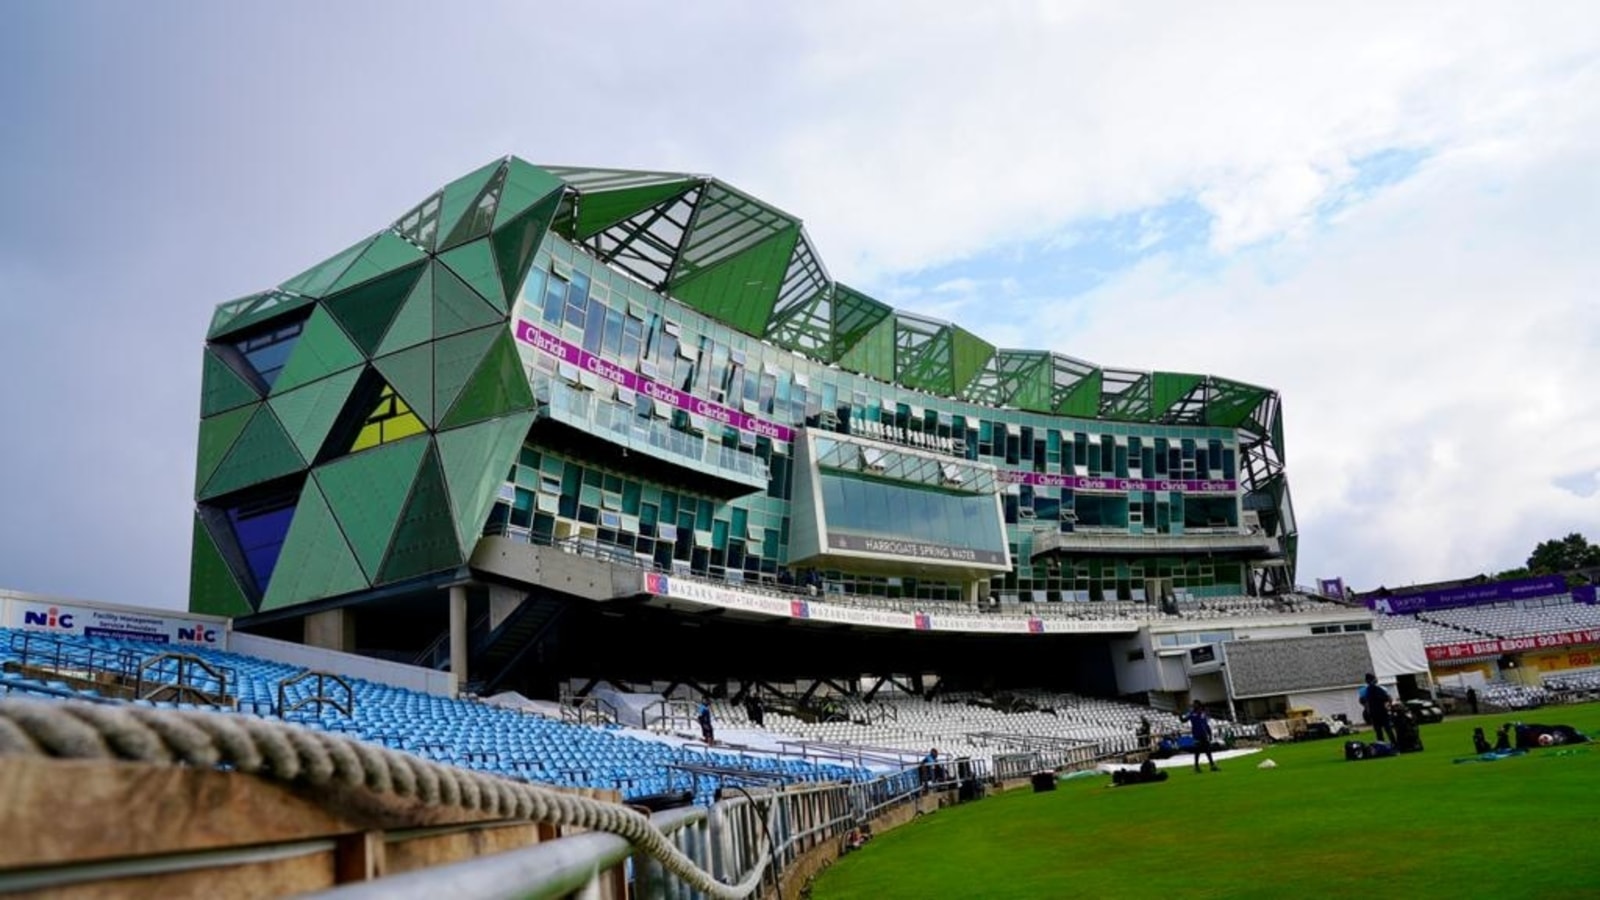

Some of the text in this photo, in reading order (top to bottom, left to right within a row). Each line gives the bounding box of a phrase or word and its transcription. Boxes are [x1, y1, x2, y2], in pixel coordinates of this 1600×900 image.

[525, 328, 779, 438] Clarion Clarion Clarion Clarion Clarion
[865, 540, 976, 560] HARROGATE SPRING WATER
[671, 583, 713, 600] MAZARS
[811, 606, 846, 620] MAZARS
